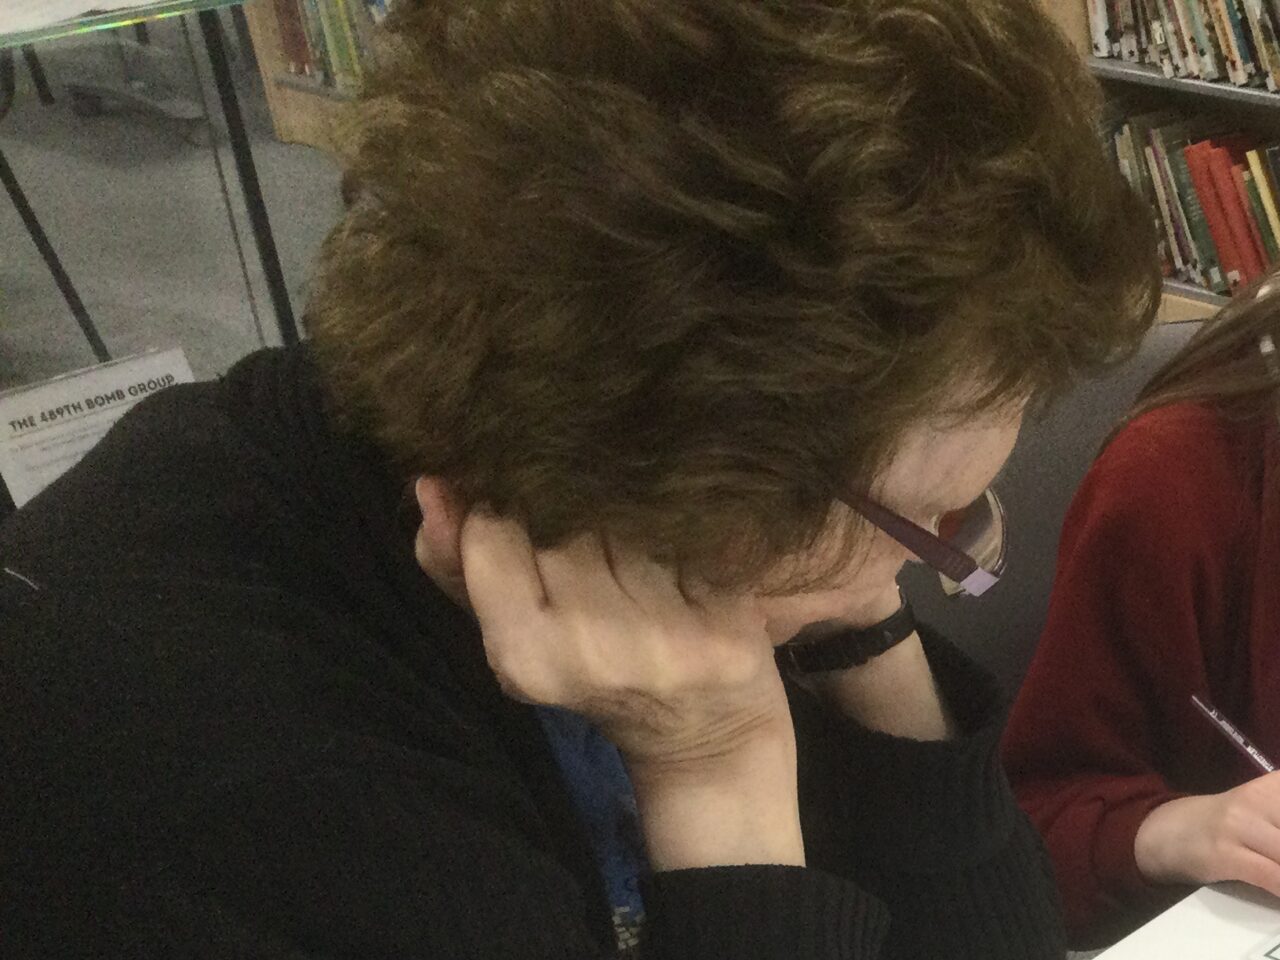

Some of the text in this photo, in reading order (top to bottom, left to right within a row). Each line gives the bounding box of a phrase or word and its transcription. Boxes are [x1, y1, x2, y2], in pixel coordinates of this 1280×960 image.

[9, 374, 175, 432] THE 489TH BOMB GROUP
